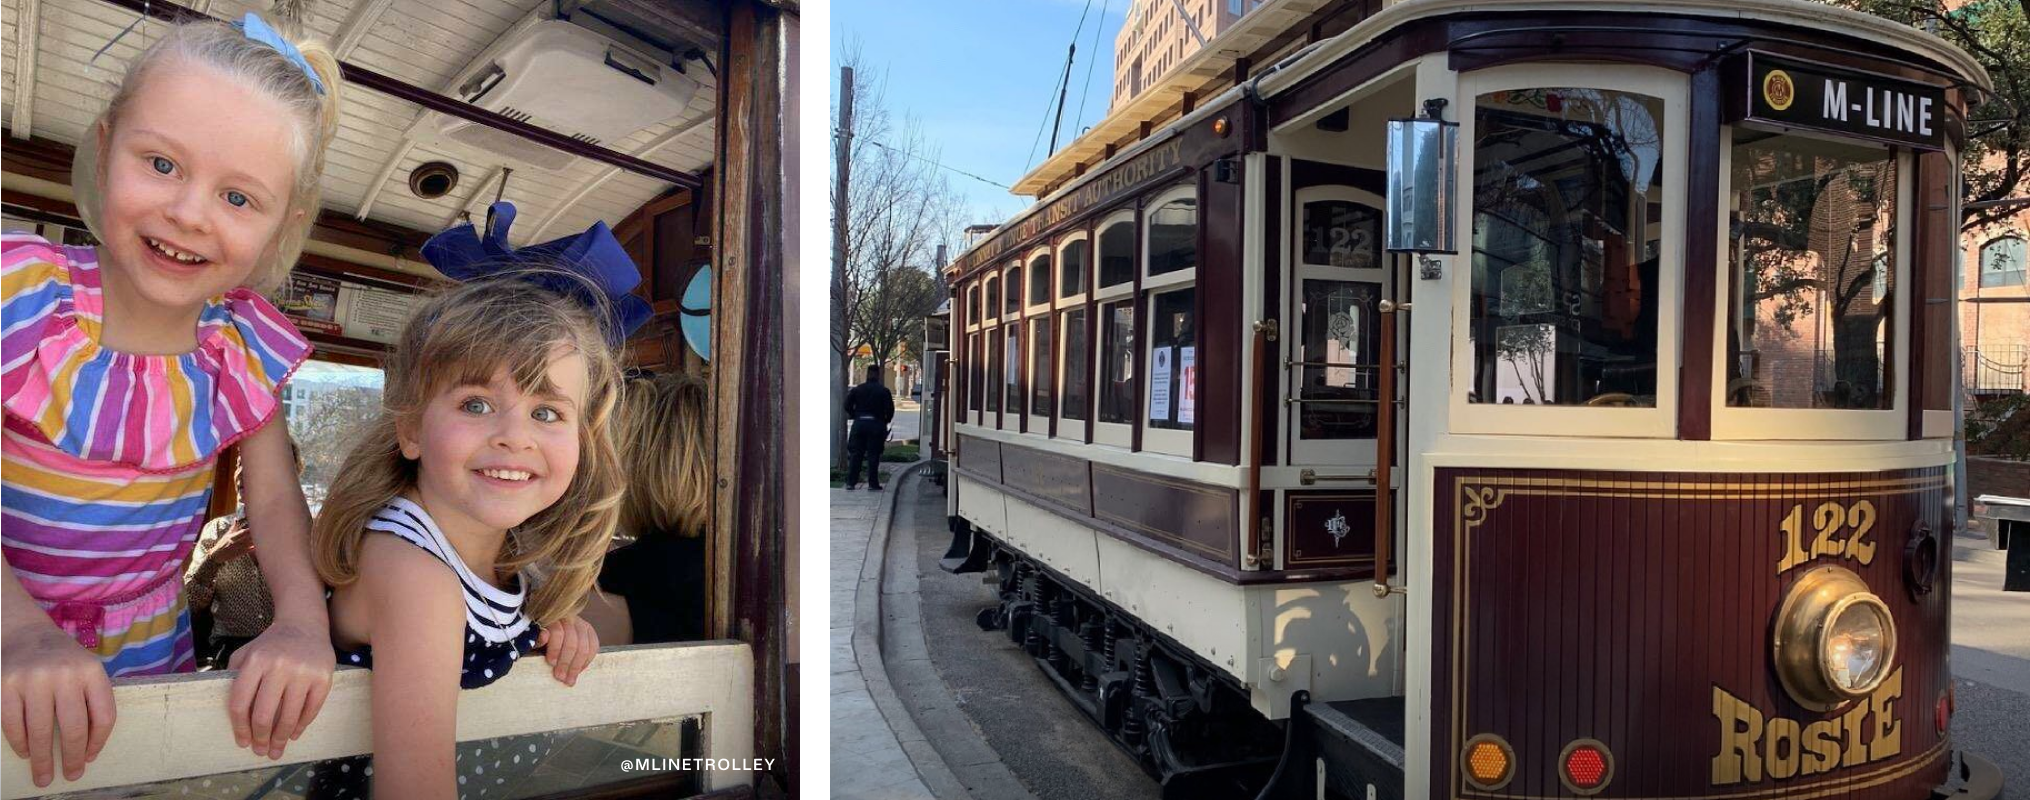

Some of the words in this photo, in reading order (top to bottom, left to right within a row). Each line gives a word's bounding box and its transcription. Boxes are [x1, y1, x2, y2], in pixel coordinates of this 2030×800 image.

[1823, 79, 1932, 136] M-LINE
[1083, 138, 1183, 207] AUTHORITY
[1309, 226, 1373, 253] 122
[1777, 500, 1876, 575] 122
[1711, 664, 1903, 785] ROSIE
